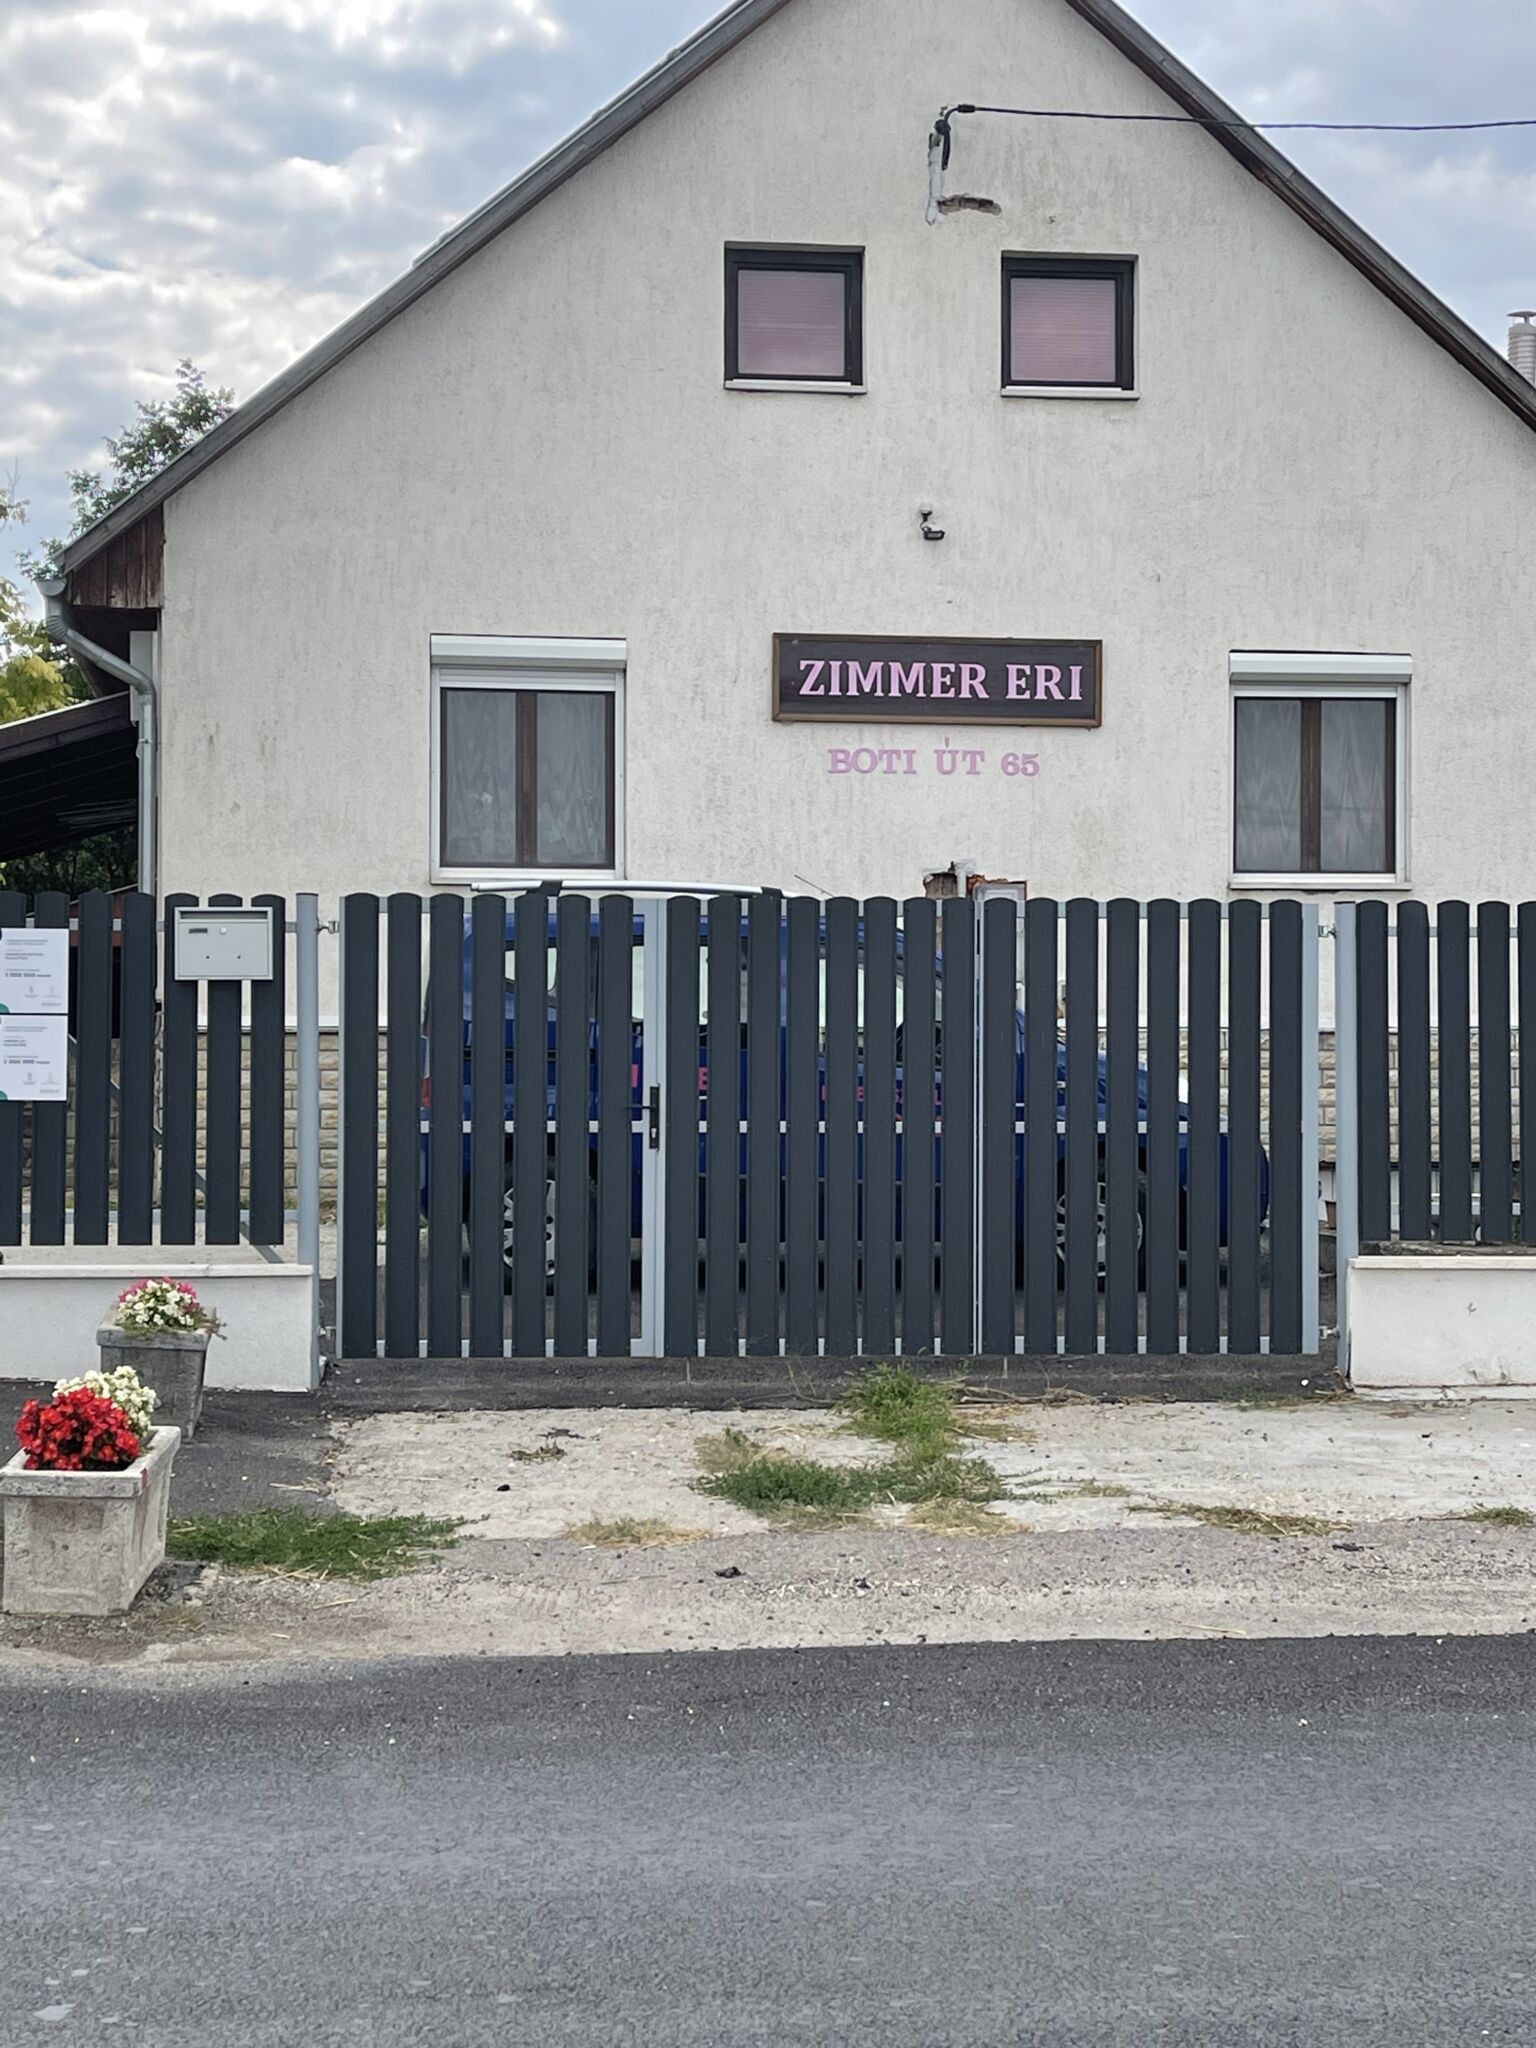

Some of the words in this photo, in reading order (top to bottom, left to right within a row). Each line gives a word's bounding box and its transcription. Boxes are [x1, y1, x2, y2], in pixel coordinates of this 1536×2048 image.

[799, 660, 989, 699] ZIMMER
[1005, 664, 1083, 701] ERI
[828, 748, 917, 774] BOTI
[1000, 752, 1040, 776] 65
